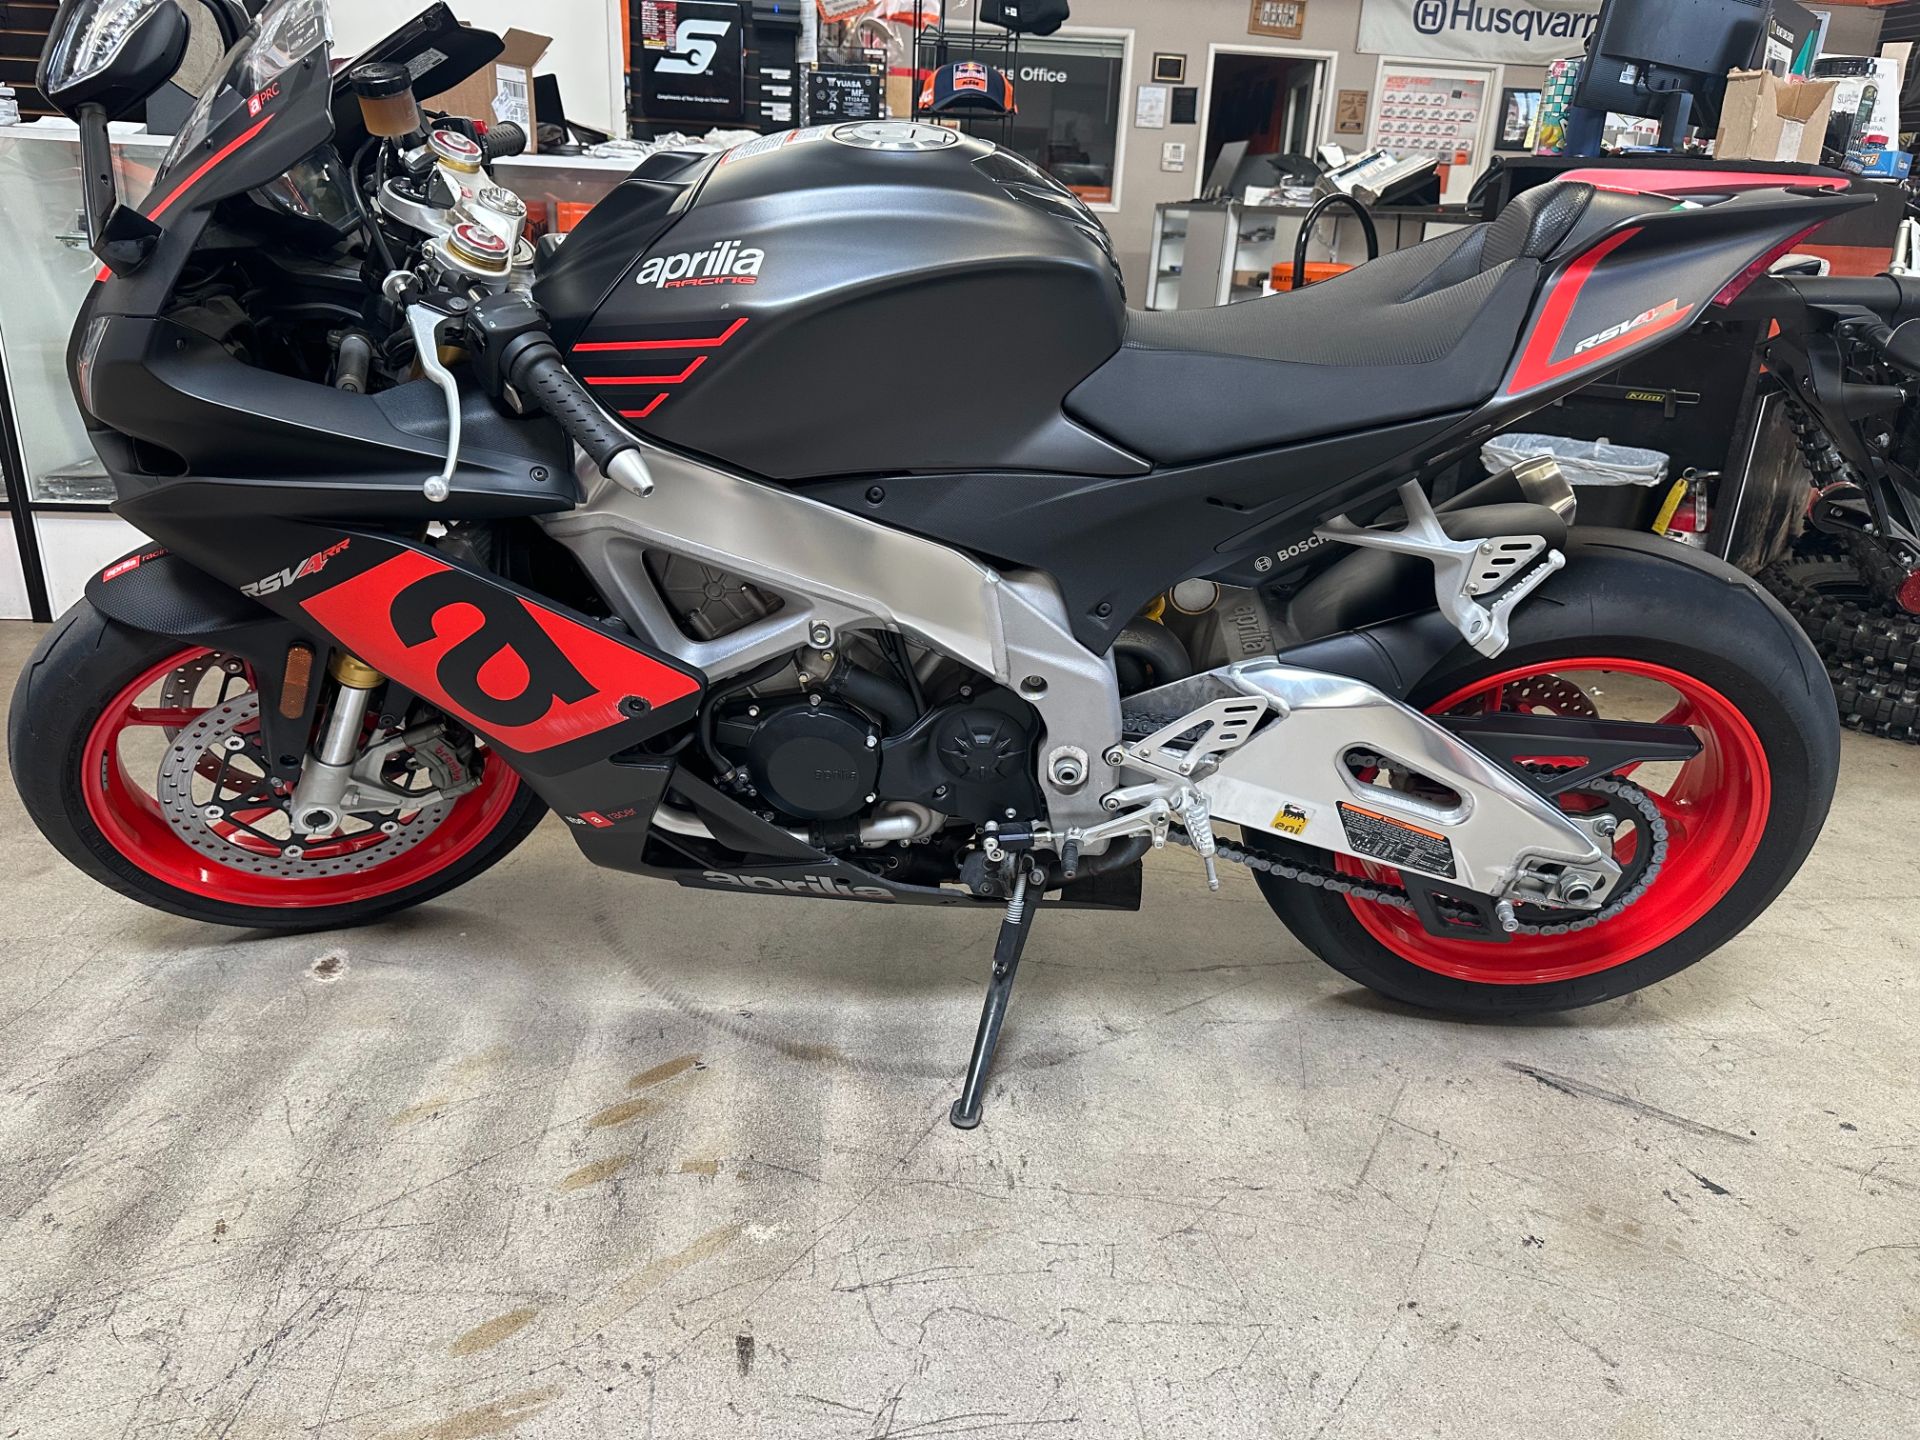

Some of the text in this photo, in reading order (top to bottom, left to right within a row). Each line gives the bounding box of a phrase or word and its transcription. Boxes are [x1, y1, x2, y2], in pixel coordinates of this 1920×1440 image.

[1449, 0, 1600, 41] Husqvarn
[1020, 67, 1067, 83] Office
[836, 80, 861, 88] YUASA
[851, 88, 865, 97] MF
[635, 240, 765, 289] aprilia
[664, 275, 758, 289] RACING
[1228, 606, 1271, 655] aprilia
[815, 768, 857, 785] aprilia
[1274, 819, 1302, 836] eni
[702, 870, 895, 899] aprilia
